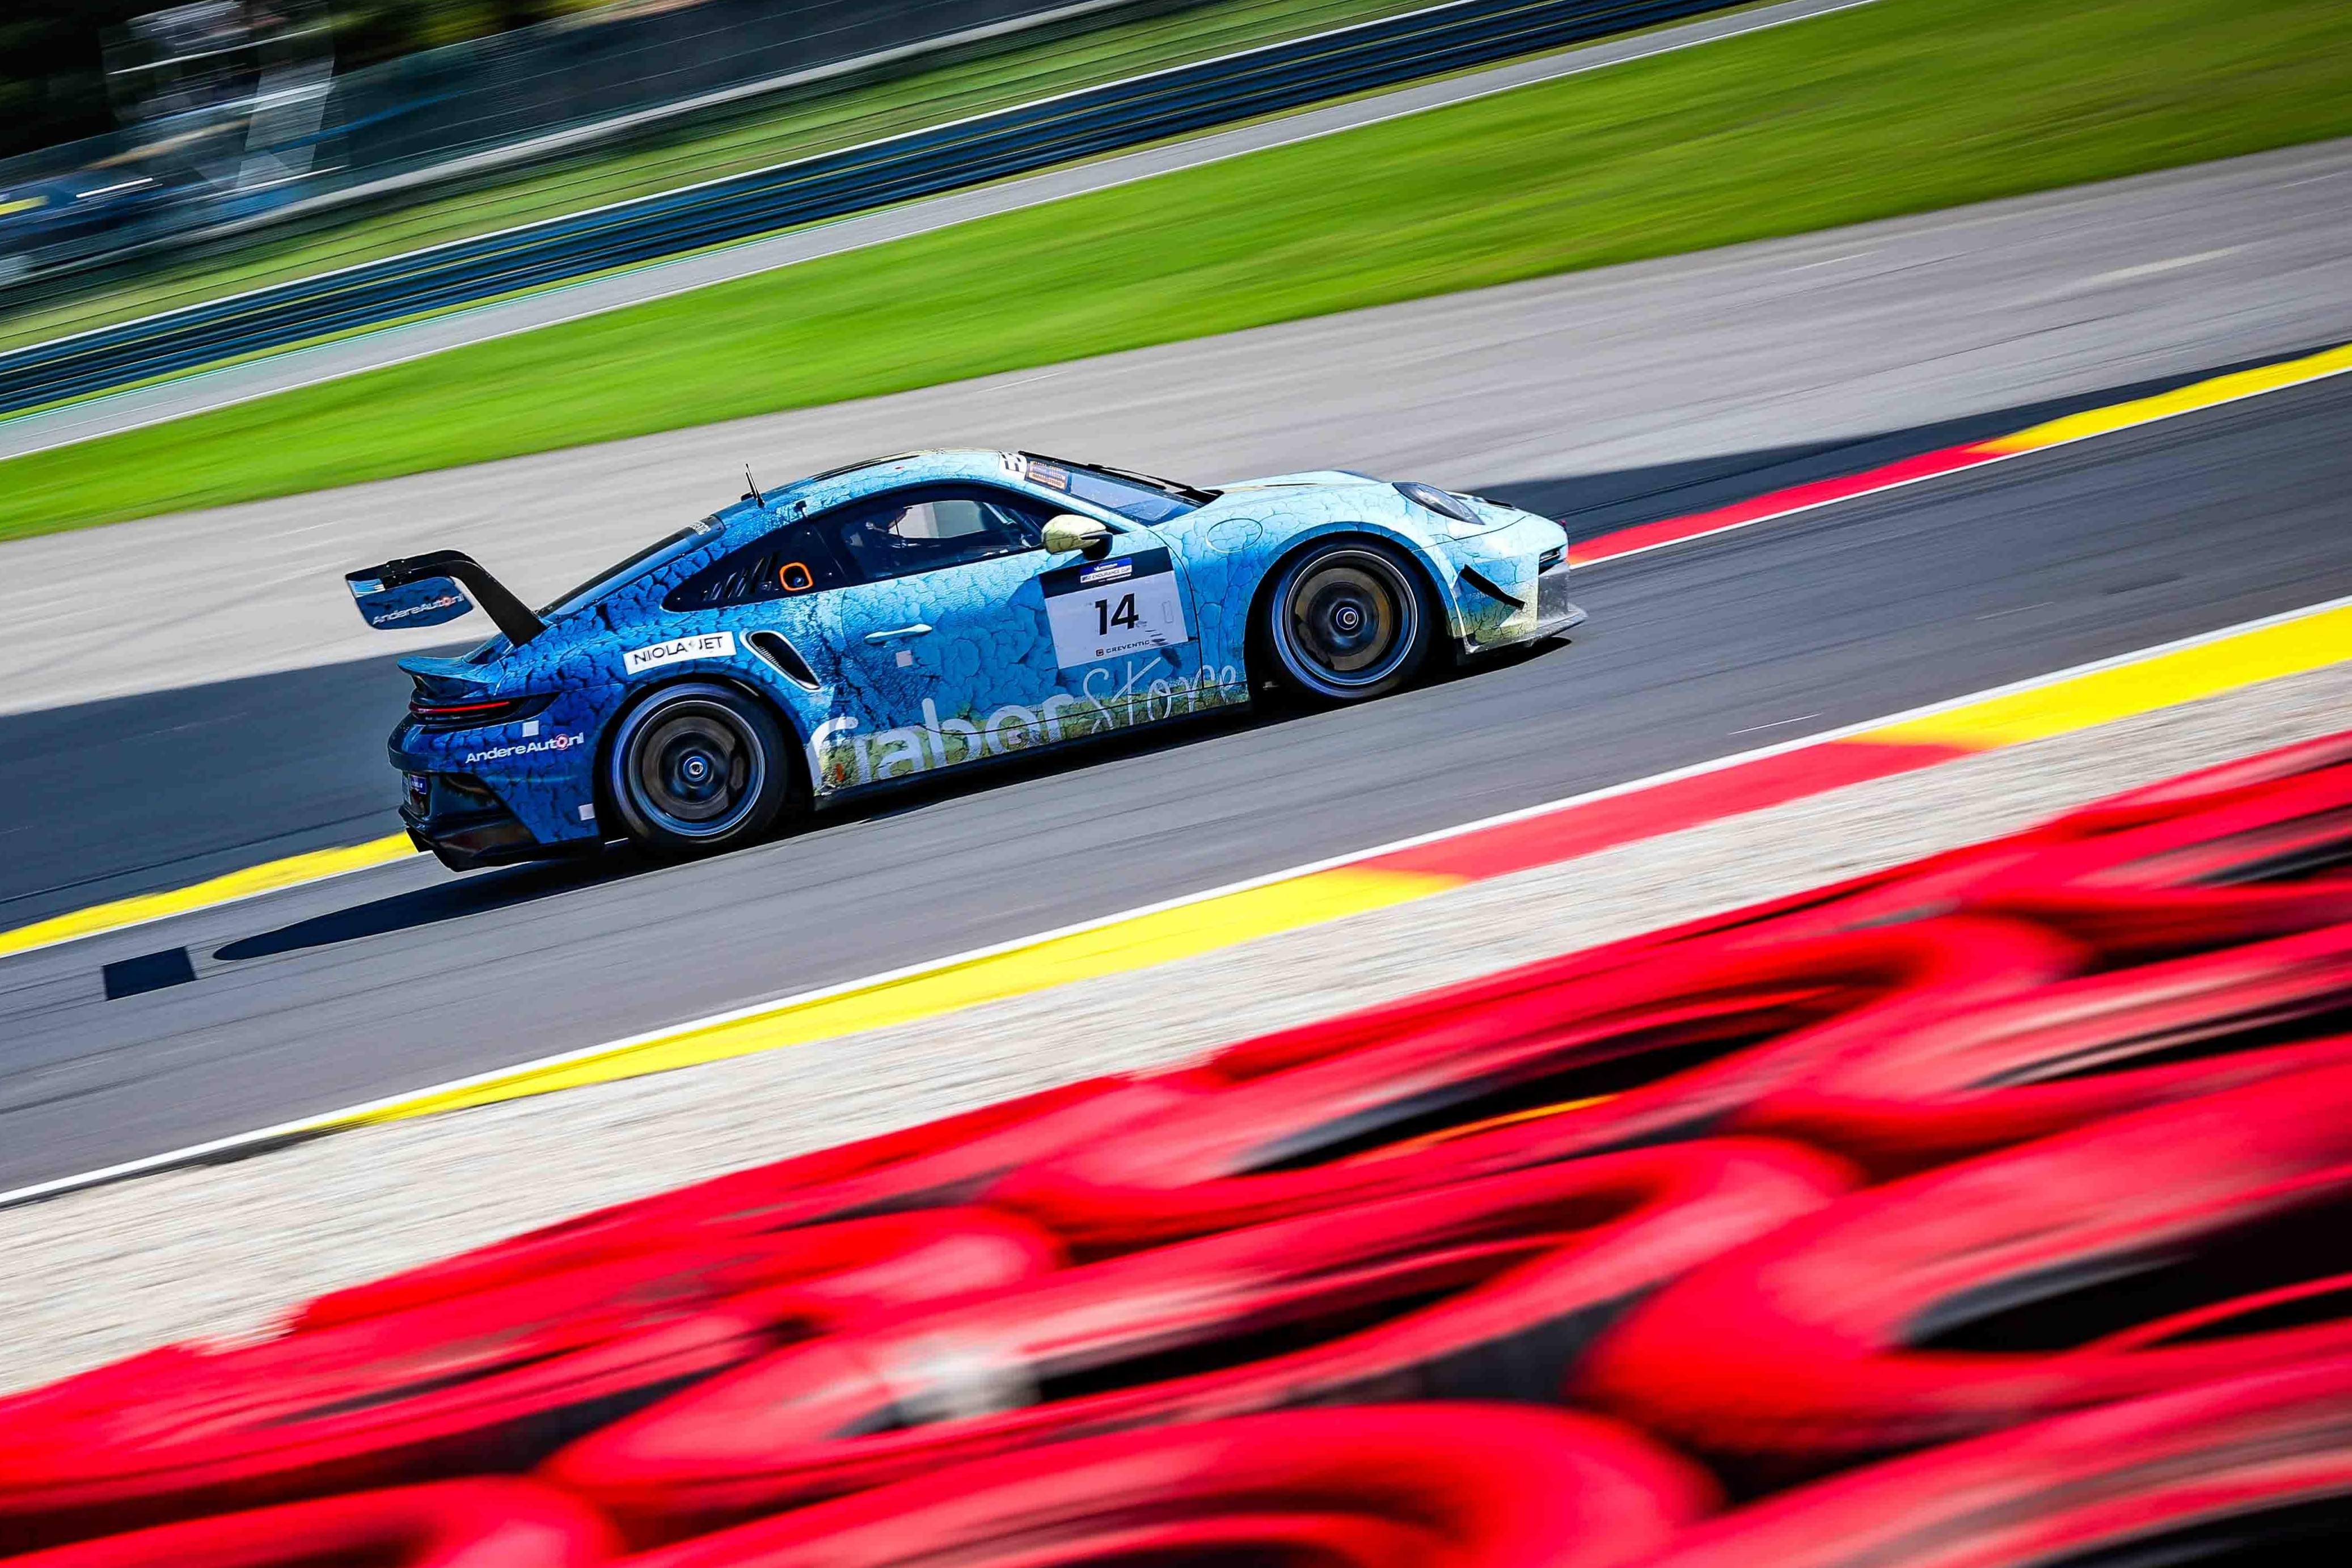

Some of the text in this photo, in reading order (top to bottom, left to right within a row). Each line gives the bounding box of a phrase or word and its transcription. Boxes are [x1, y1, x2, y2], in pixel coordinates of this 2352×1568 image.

[1095, 593, 1139, 636] 14
[634, 636, 723, 665] NIOLA JET
[1106, 639, 1151, 654] CREVENTIC
[1083, 656, 1236, 734] Store
